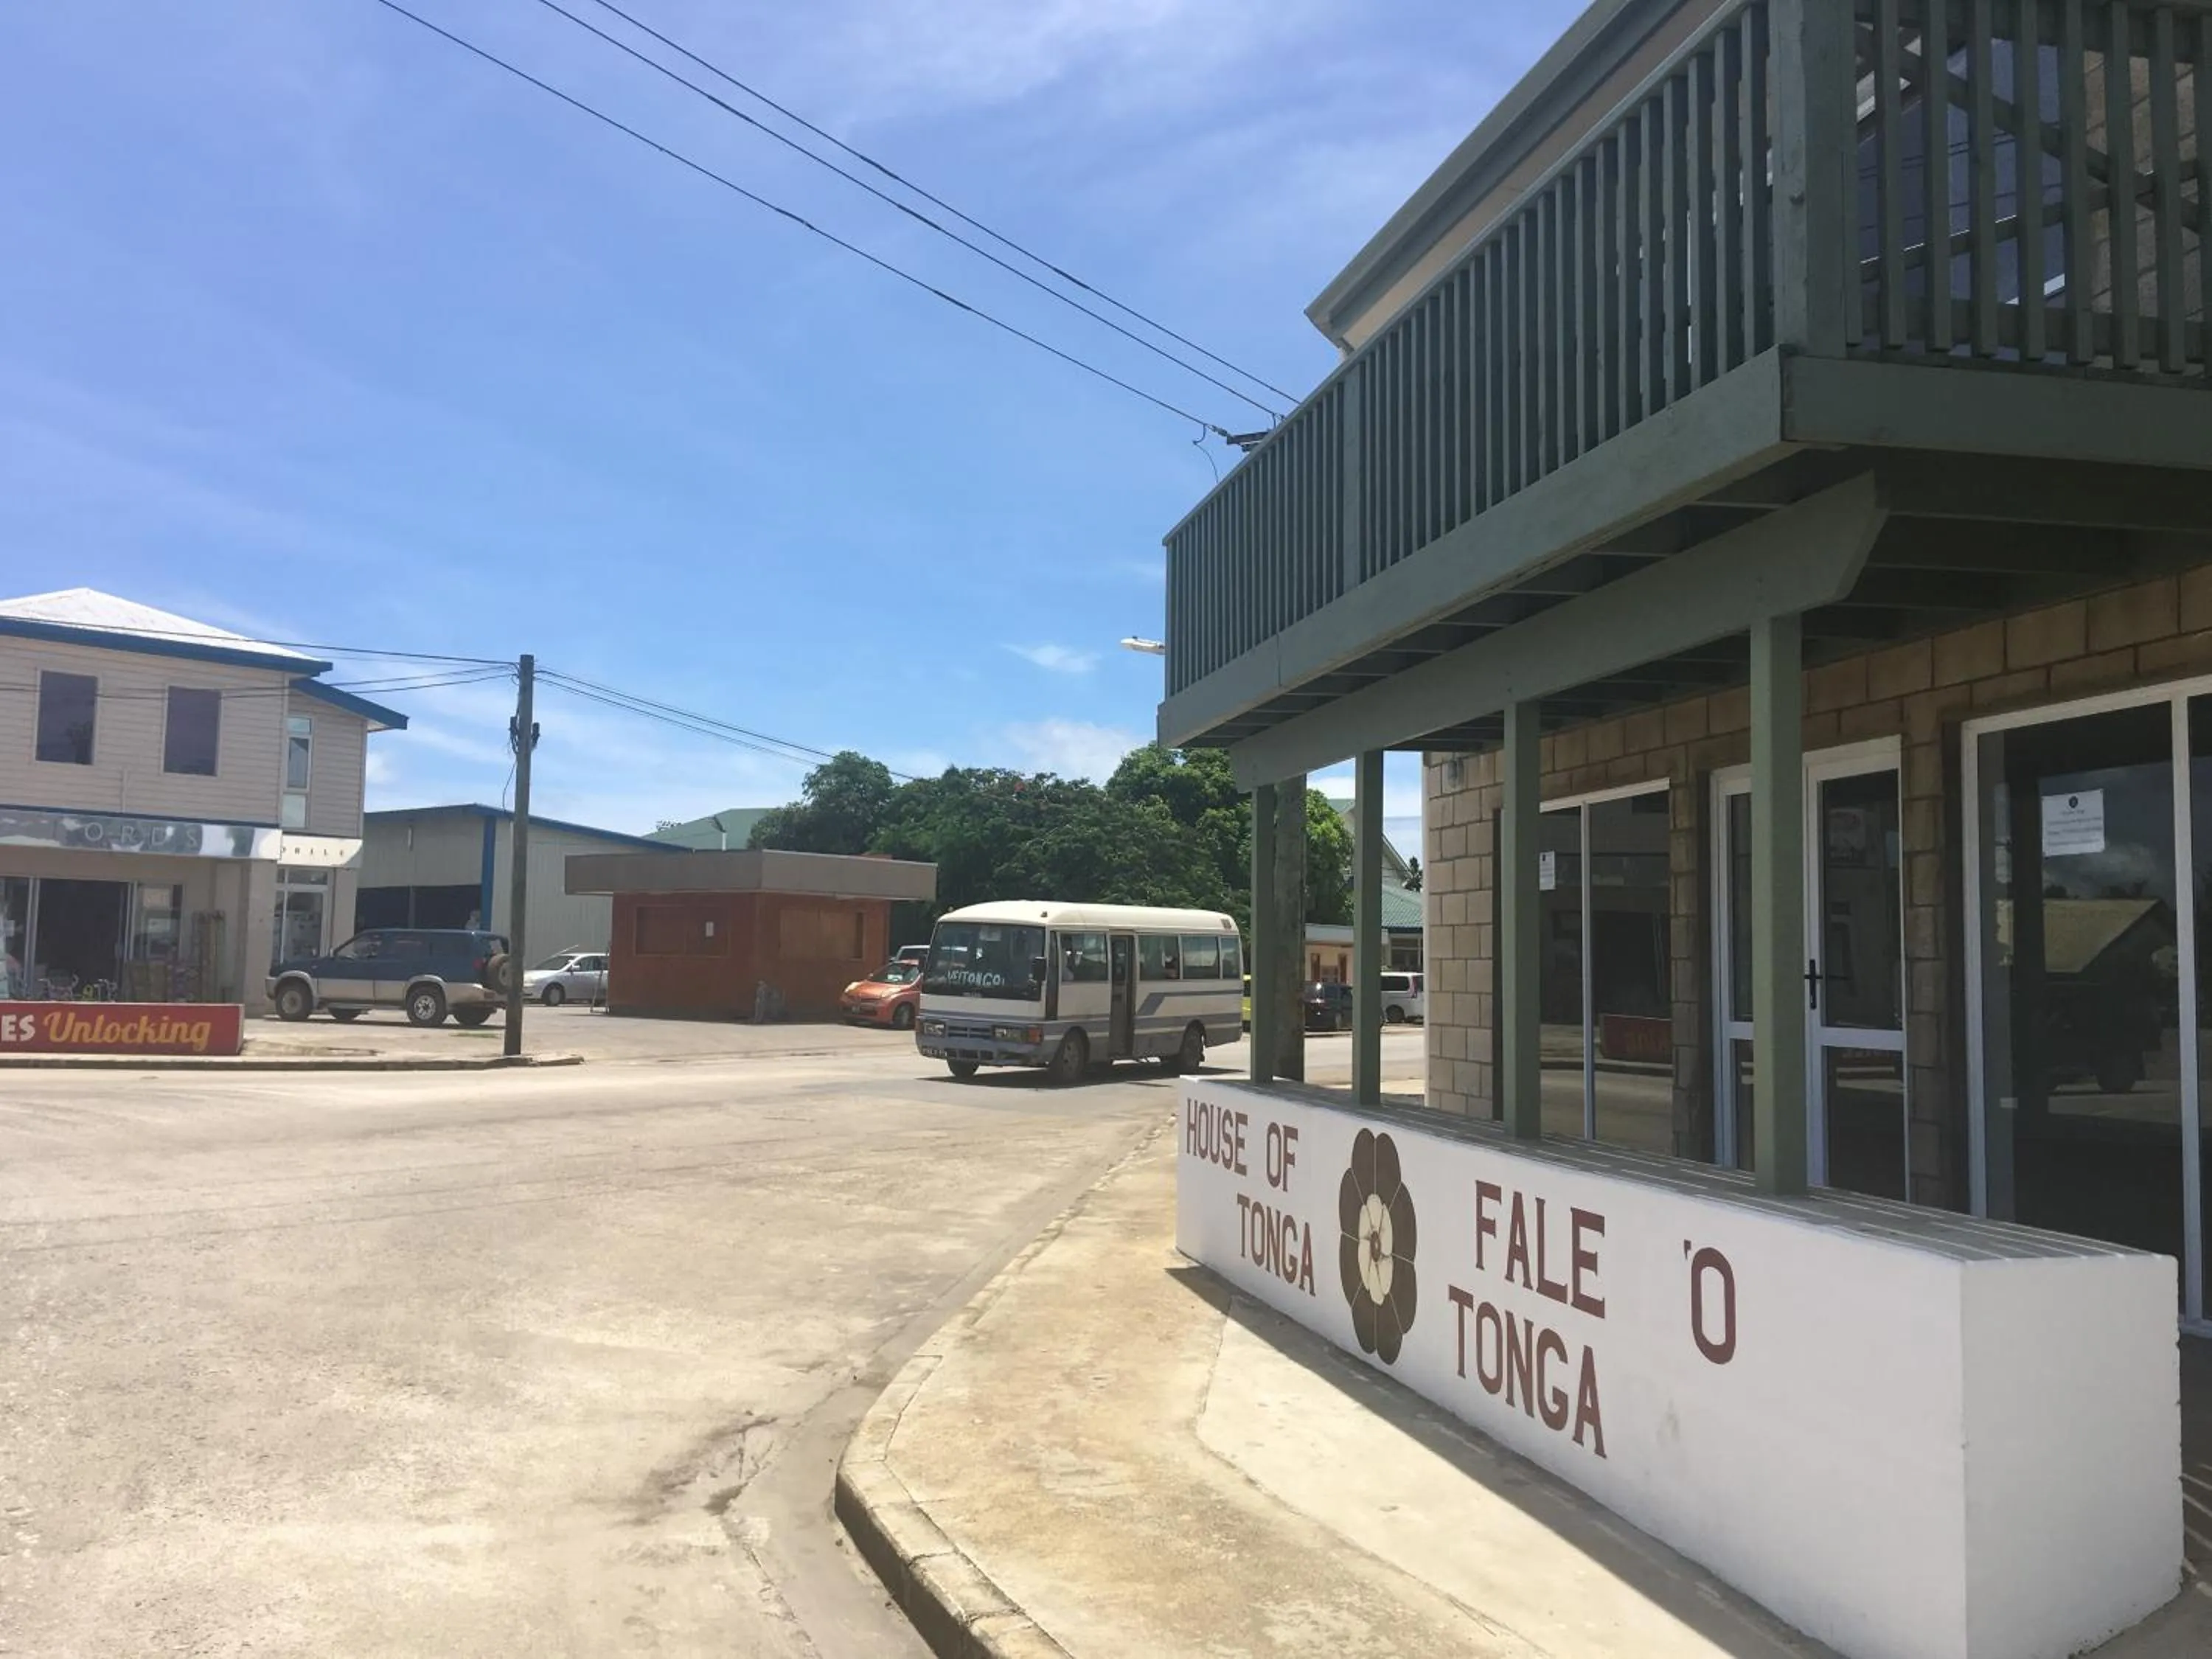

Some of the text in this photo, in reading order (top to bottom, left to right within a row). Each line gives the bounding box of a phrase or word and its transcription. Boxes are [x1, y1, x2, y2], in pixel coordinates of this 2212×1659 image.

[1, 1011, 212, 1052] ES Unlocking
[1186, 1098, 1299, 1192] HOUSE OF
[1236, 1192, 1317, 1298] TONGA
[1475, 1180, 1606, 1319] FALE
[1447, 1284, 1607, 1460] TONGA
